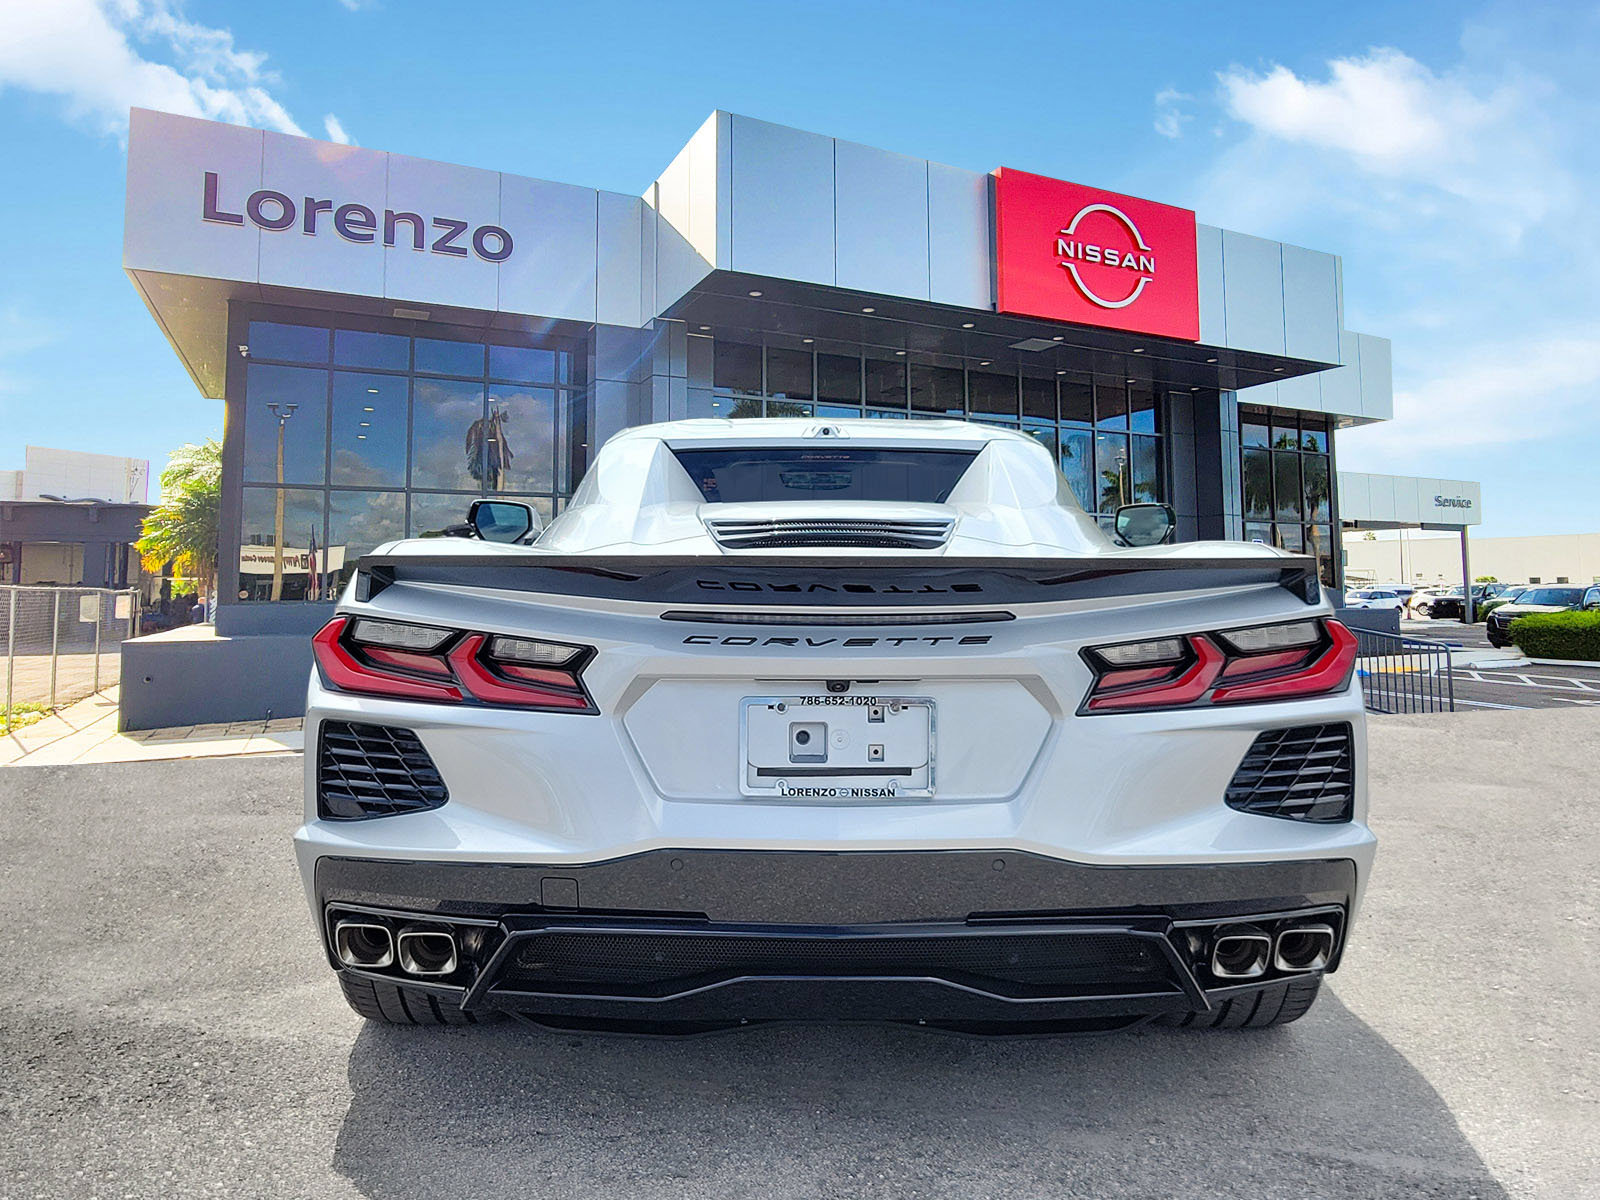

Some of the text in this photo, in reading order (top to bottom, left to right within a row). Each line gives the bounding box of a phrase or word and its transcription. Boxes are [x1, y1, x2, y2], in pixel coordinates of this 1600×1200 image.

[202, 171, 515, 263] Lorenzo
[1057, 238, 1155, 273] NISSAN
[1434, 495, 1472, 508] Service
[682, 635, 993, 648] CORVETTE
[800, 696, 877, 706] 786-652-1020
[781, 788, 896, 797] LORENZO NISSAN
